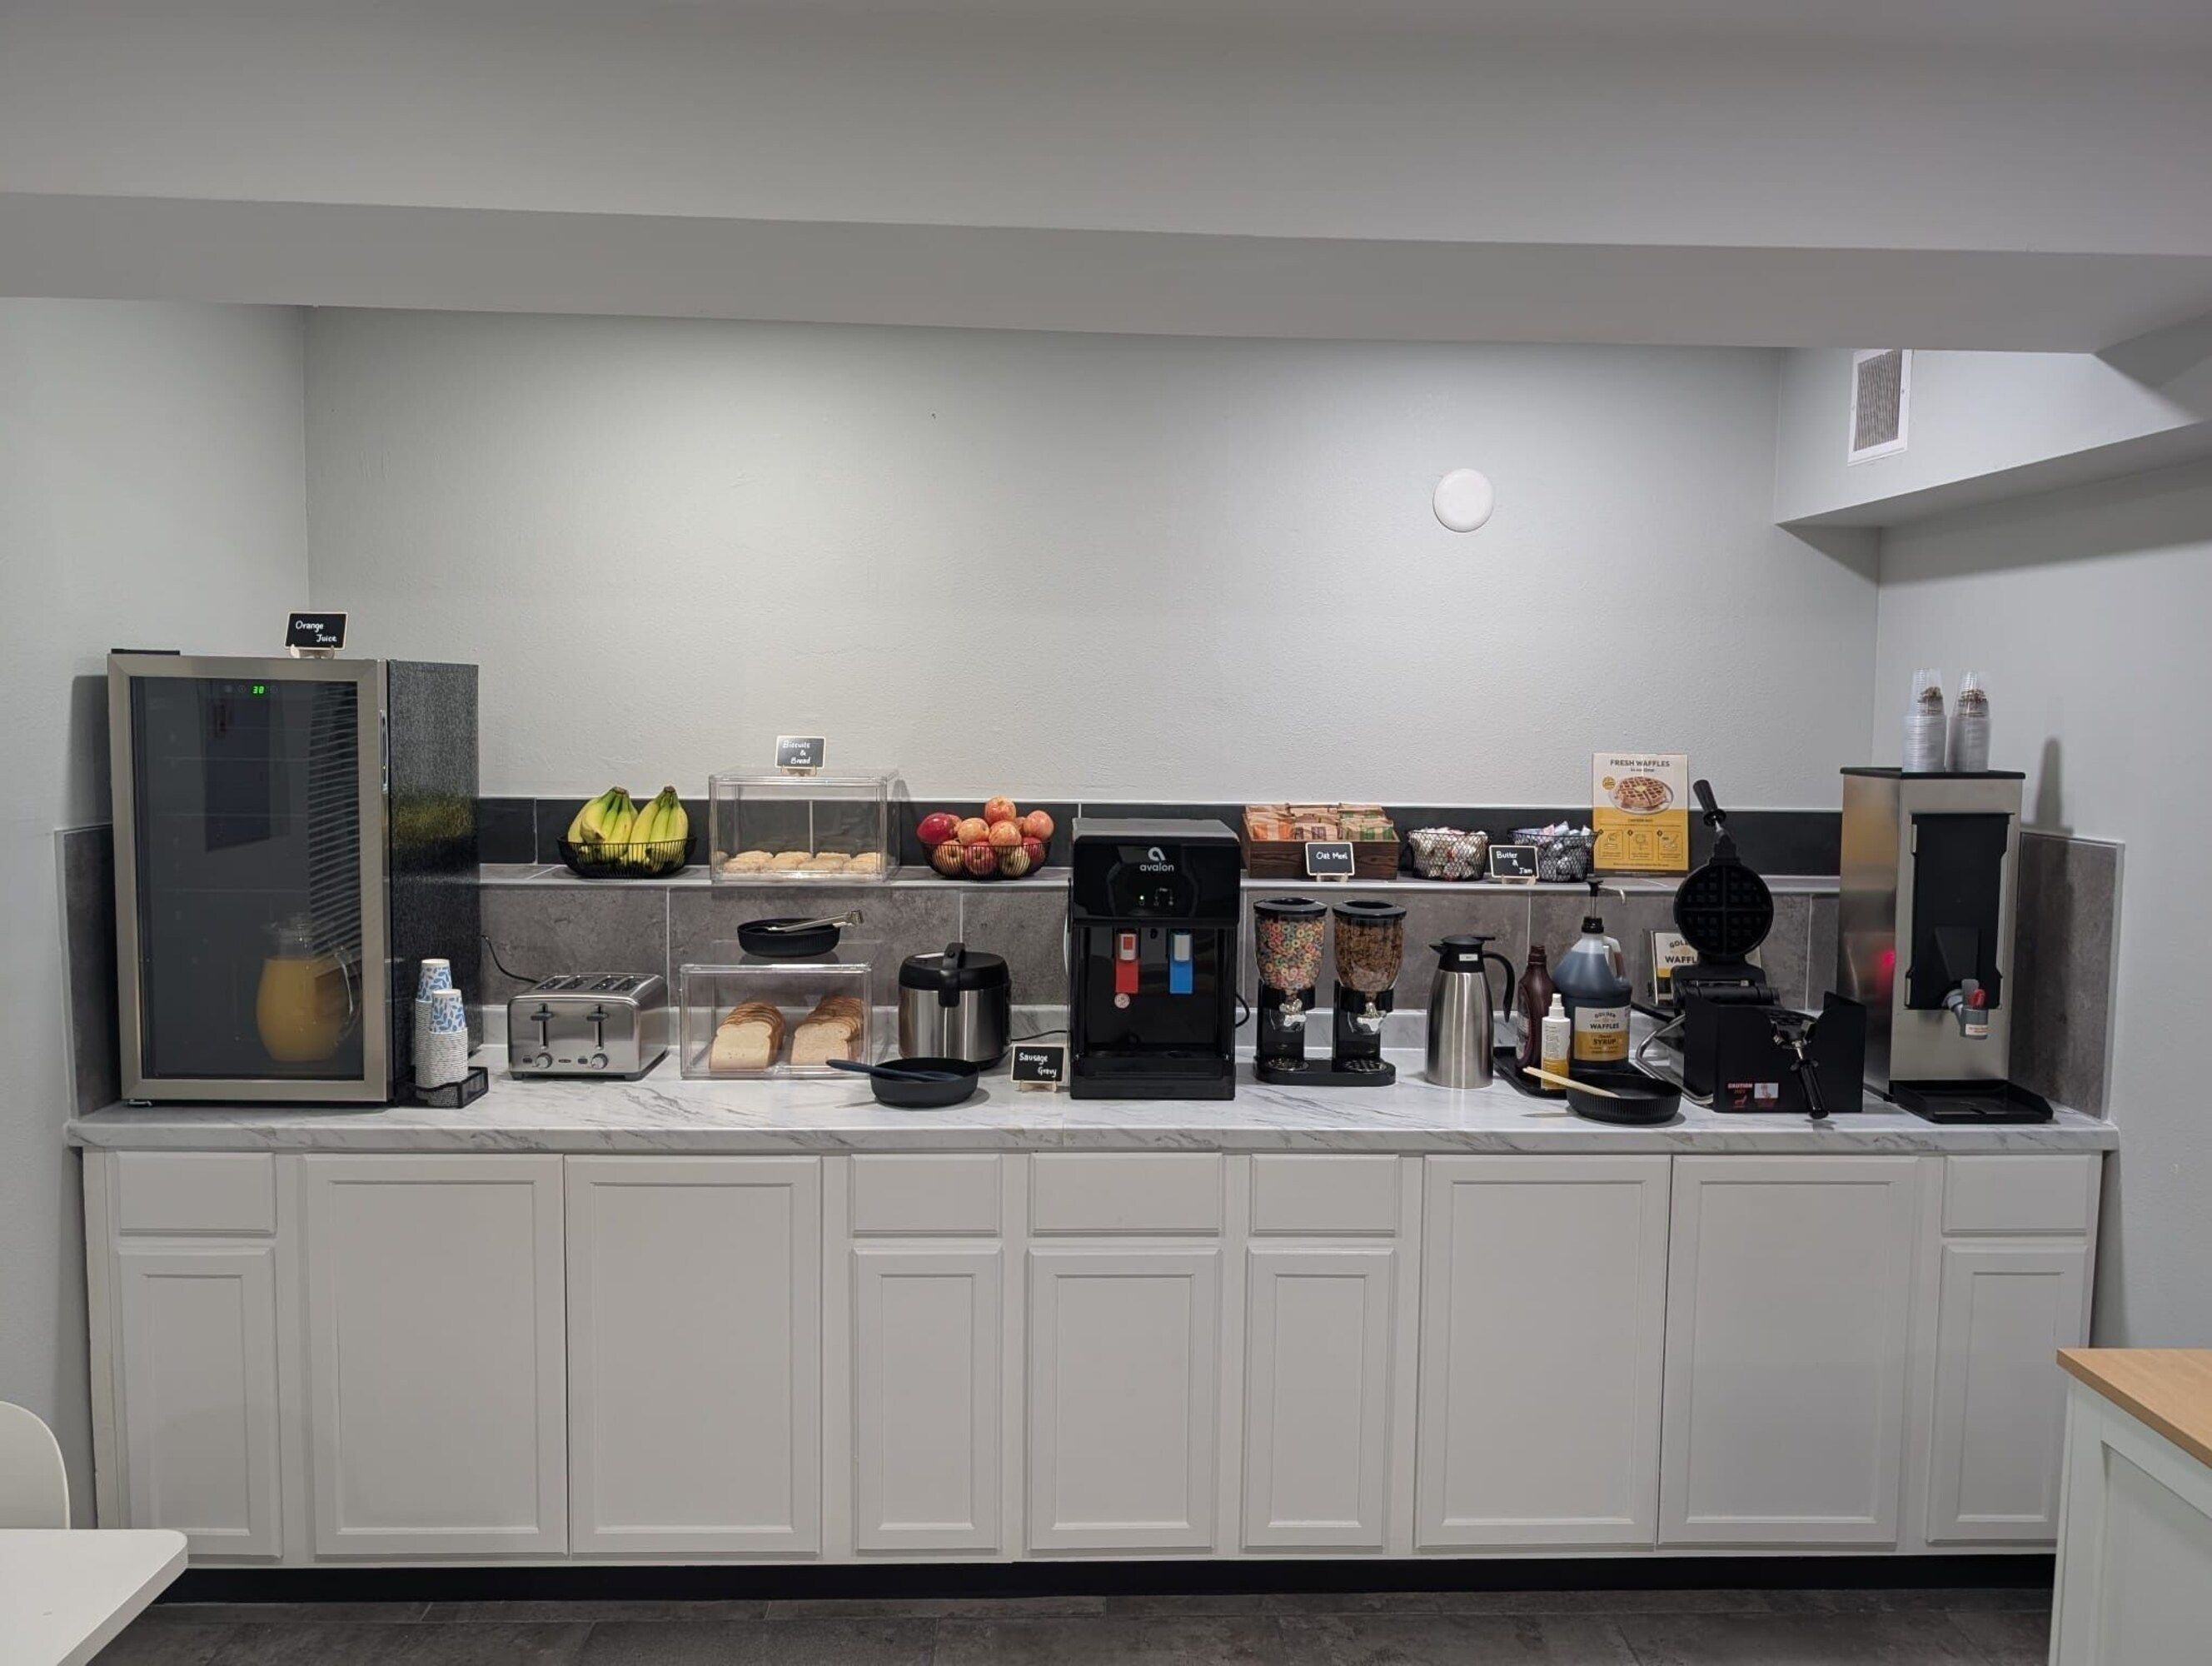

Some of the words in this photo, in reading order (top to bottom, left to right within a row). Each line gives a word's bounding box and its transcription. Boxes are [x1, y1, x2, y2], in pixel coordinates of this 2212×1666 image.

[295, 620, 324, 633] Orange
[316, 634, 337, 643] Juice
[790, 756, 811, 765] Bread
[1316, 850, 1331, 860] Oat
[1496, 850, 1517, 859] Butter
[1139, 862, 1174, 872] avalon
[1019, 1052, 1049, 1065] Sausage
[1037, 1066, 1057, 1078] Gravy
